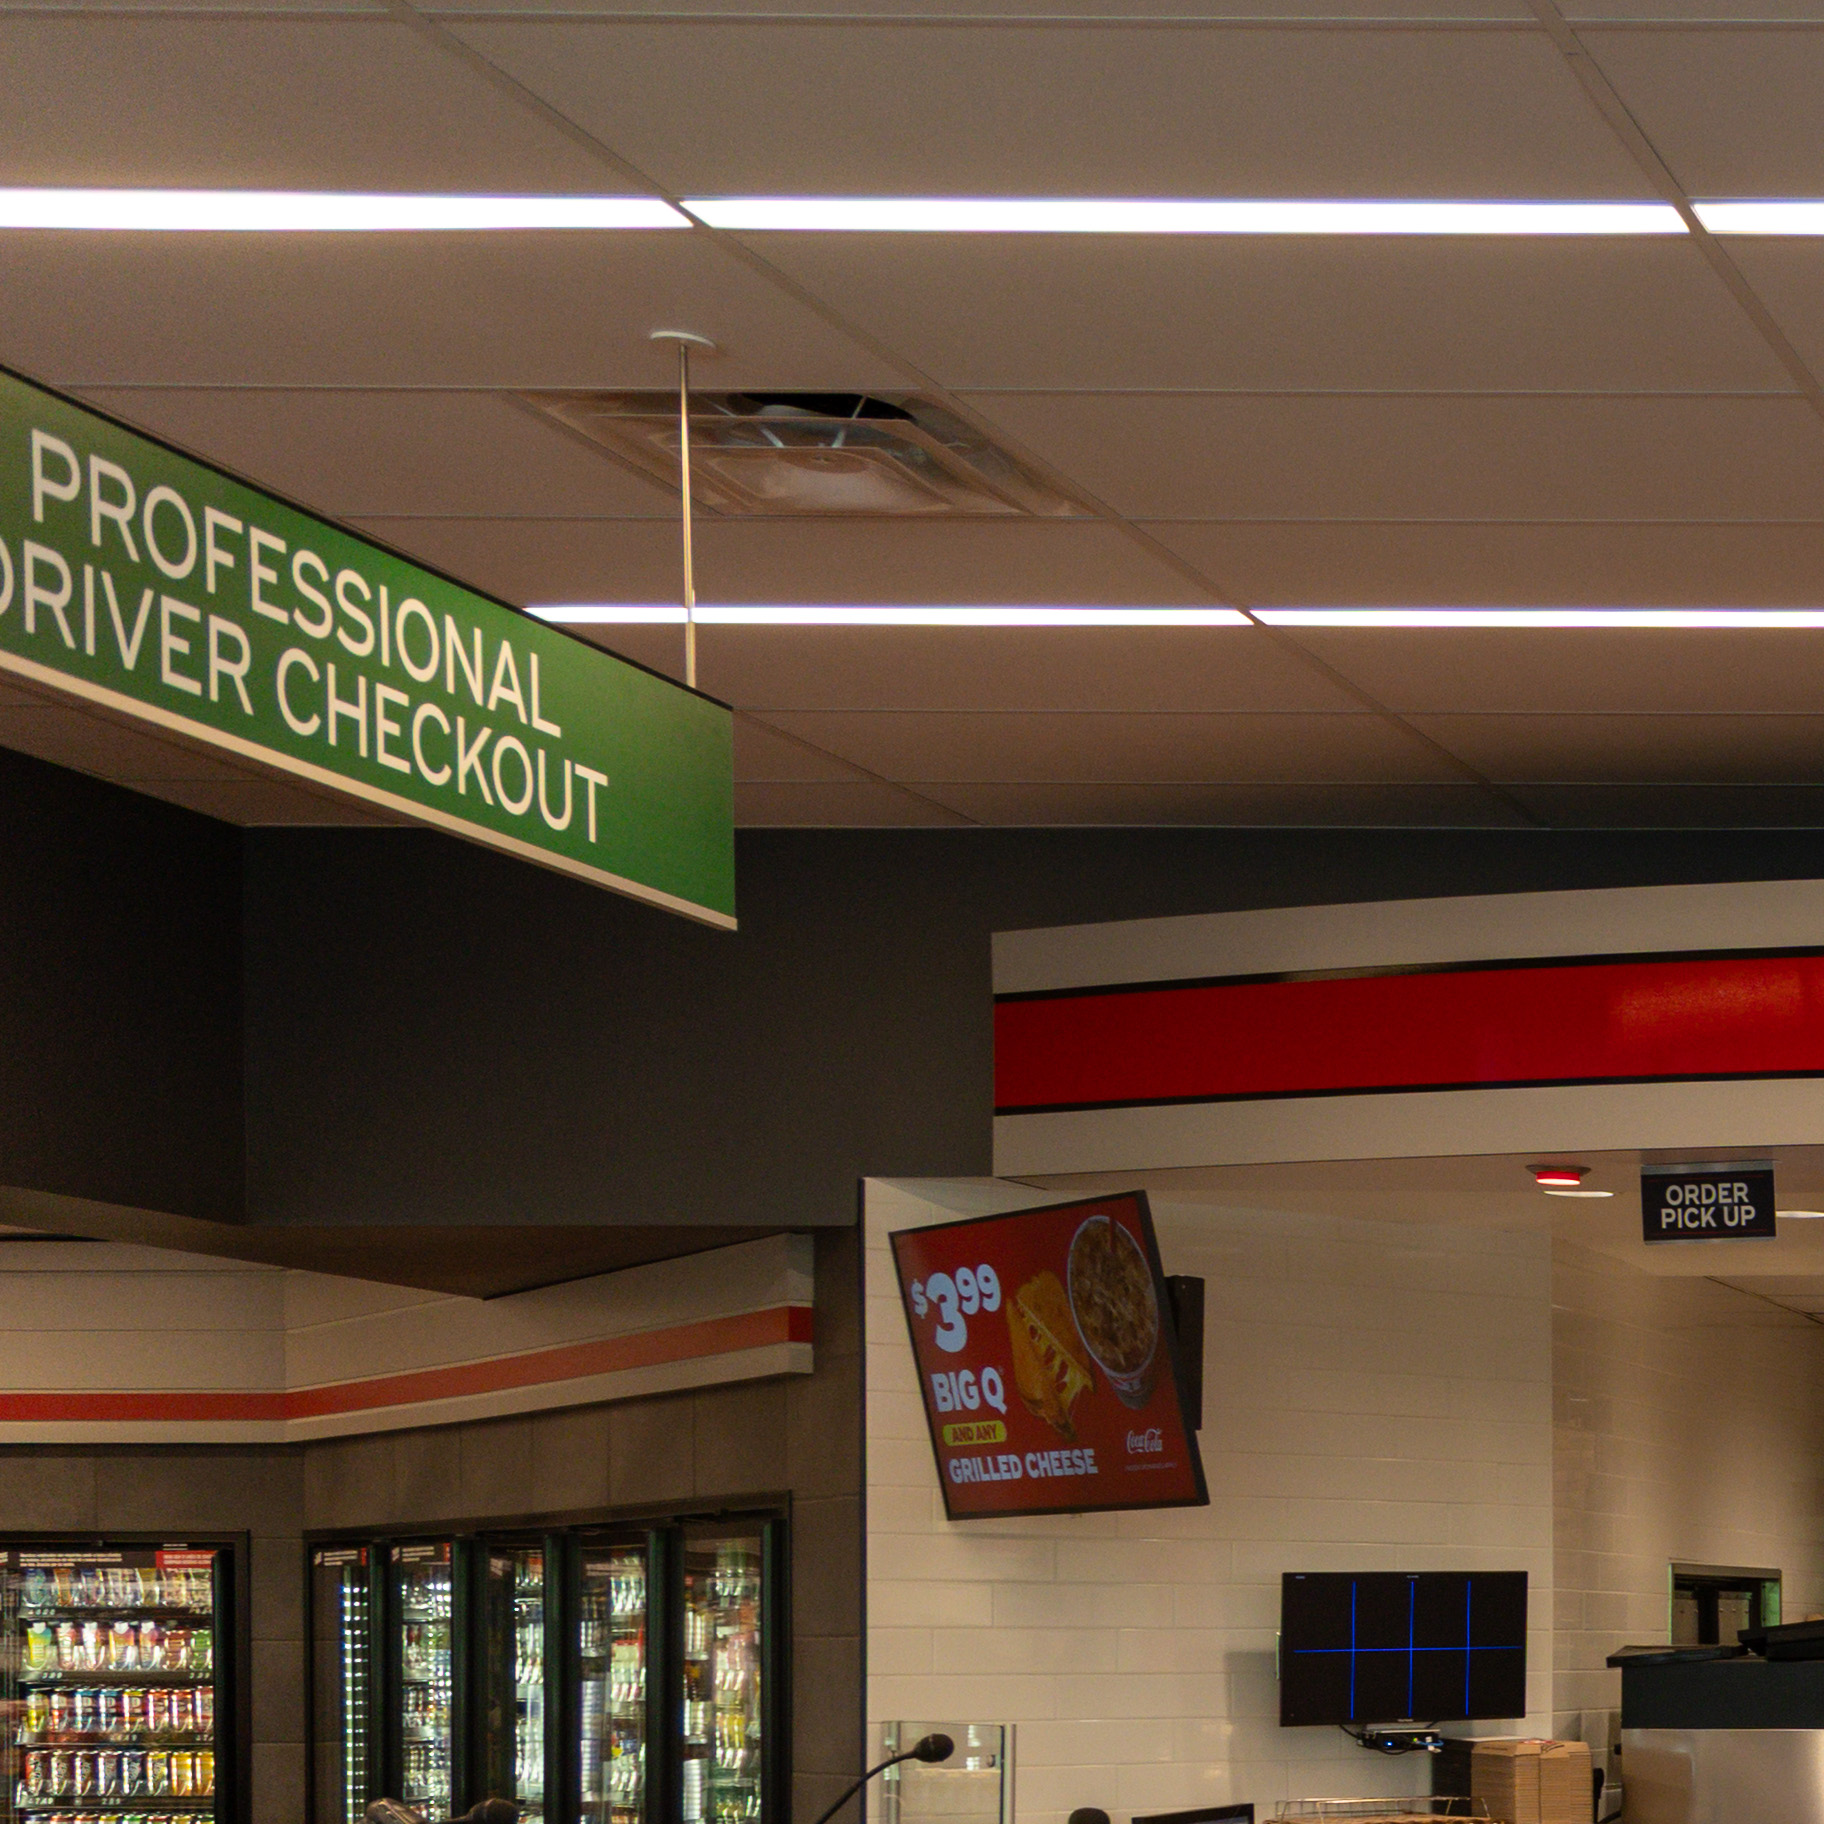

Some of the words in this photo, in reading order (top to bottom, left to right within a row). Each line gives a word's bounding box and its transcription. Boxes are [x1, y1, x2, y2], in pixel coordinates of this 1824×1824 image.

[31, 428, 562, 739] PROFESSIONAL
[276, 647, 609, 845] CHECKOUT
[1666, 1182, 1749, 1205] ORDER
[1661, 1207, 1717, 1229] PICK
[1723, 1205, 1756, 1227] UP
[931, 1369, 979, 1413] BIG
[981, 1366, 1008, 1415] Q
[951, 1425, 975, 1442] AND
[976, 1423, 998, 1441] ANY
[949, 1454, 1023, 1484] GRILLED
[1025, 1448, 1098, 1479] CHEESE
